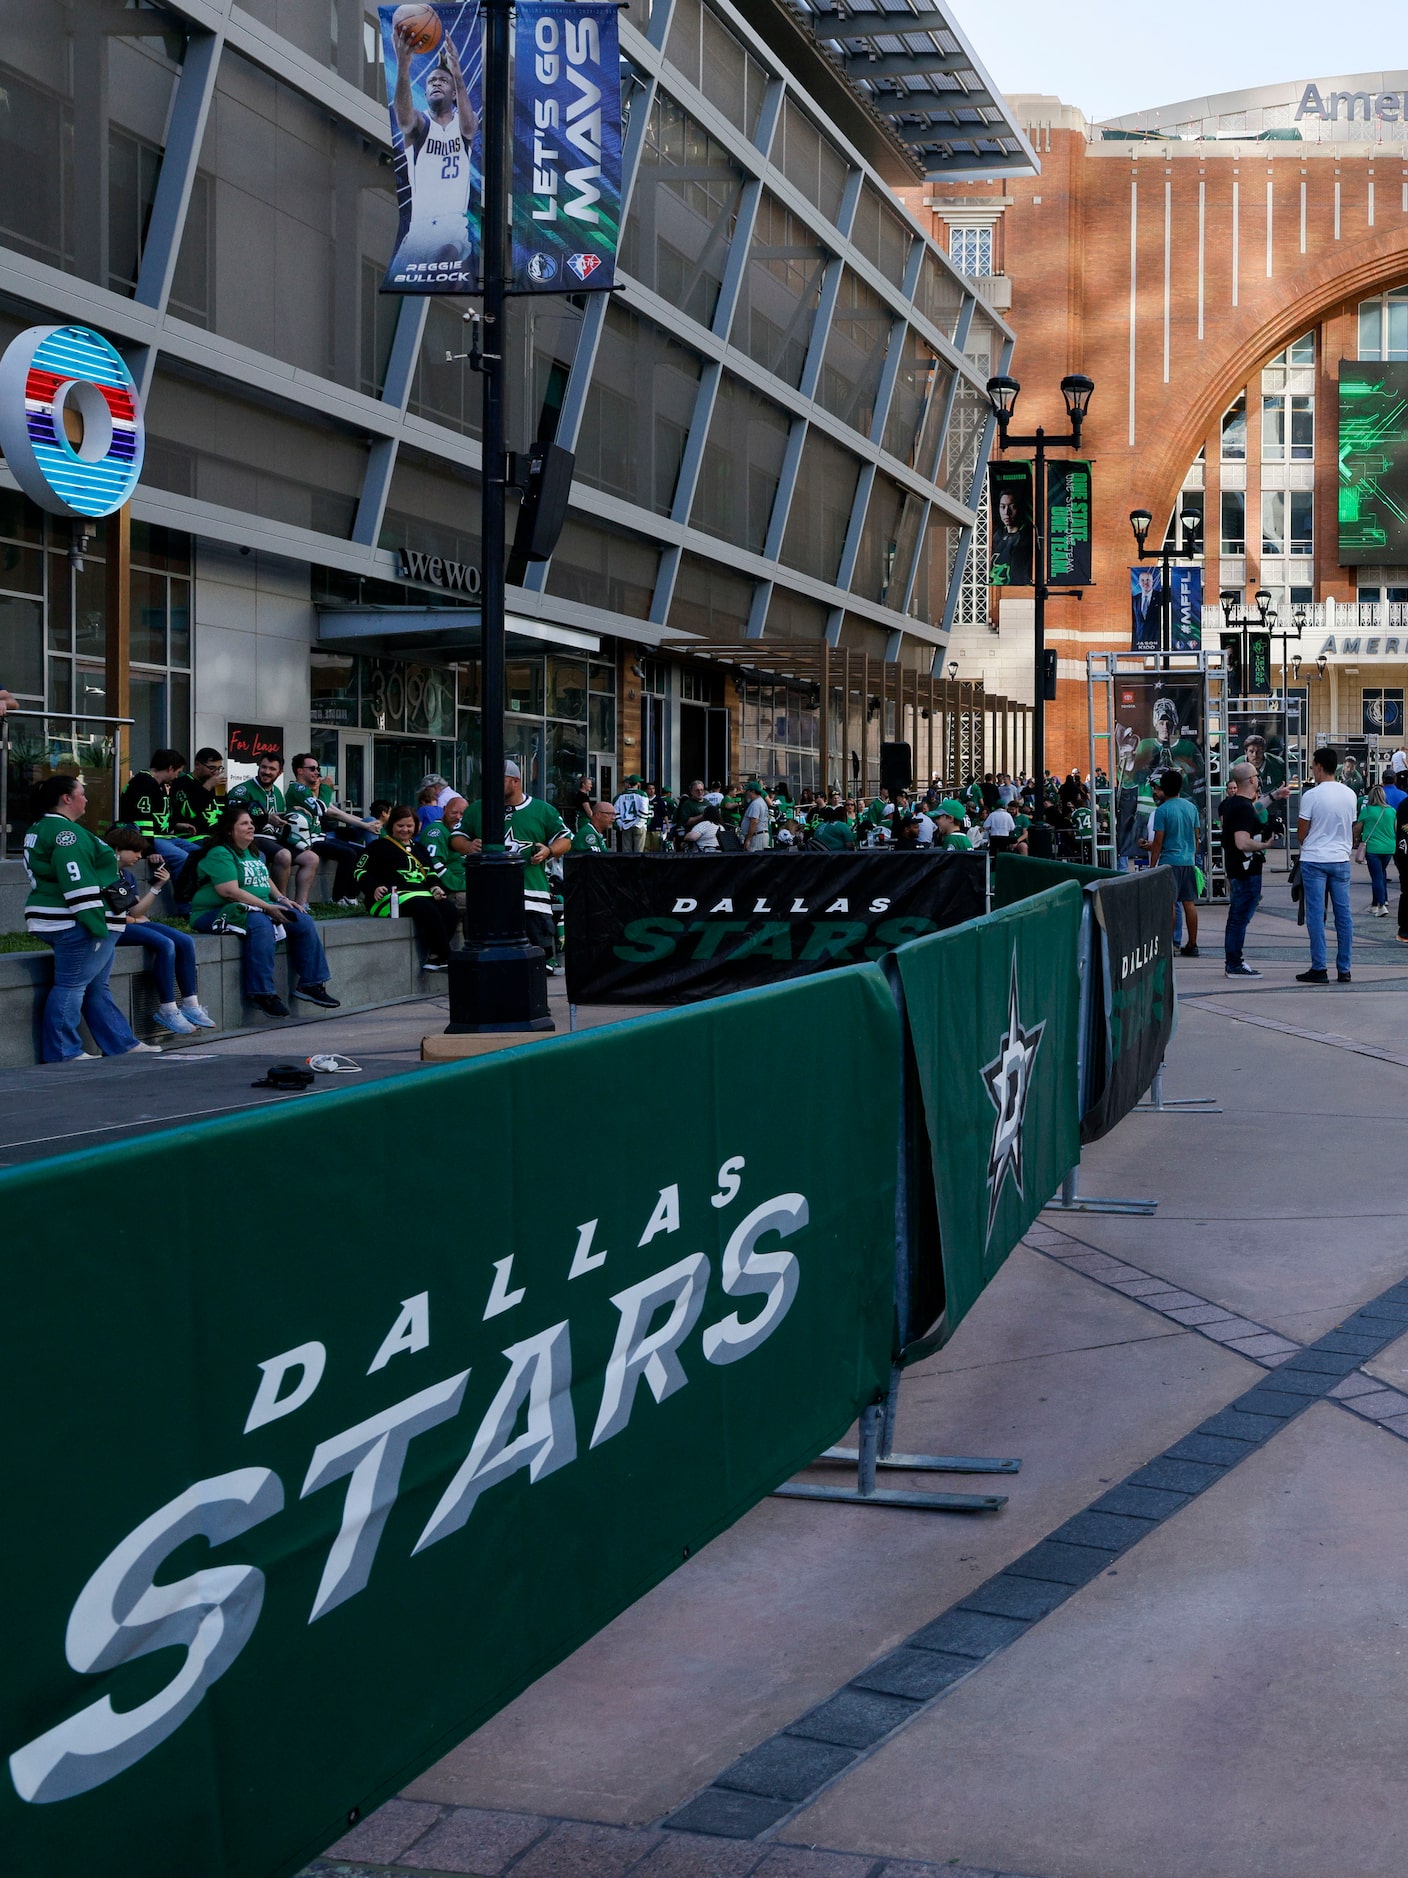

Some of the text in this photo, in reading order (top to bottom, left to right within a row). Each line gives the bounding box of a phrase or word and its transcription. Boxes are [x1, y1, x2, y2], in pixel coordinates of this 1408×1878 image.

[532, 16, 559, 221] LET'S GO
[563, 17, 602, 224] MAVS
[426, 138, 461, 156] DALLAS
[441, 156, 460, 179] 25
[394, 271, 470, 283] BULLOCK
[406, 260, 463, 272] REGGIE
[404, 549, 482, 594] wewo
[1180, 571, 1192, 635] #MFFL
[371, 669, 439, 723] 3090
[229, 729, 280, 757] For Lease
[137, 795, 151, 814] 4
[623, 801, 637, 820] 14
[1076, 815, 1092, 830] 14
[66, 861, 81, 882] 9
[671, 897, 892, 913] DALLAS
[612, 916, 938, 963] STARS
[1121, 935, 1159, 979] DALLAS
[242, 1155, 746, 1435] DALLAS
[8, 1192, 810, 1803] STARS
